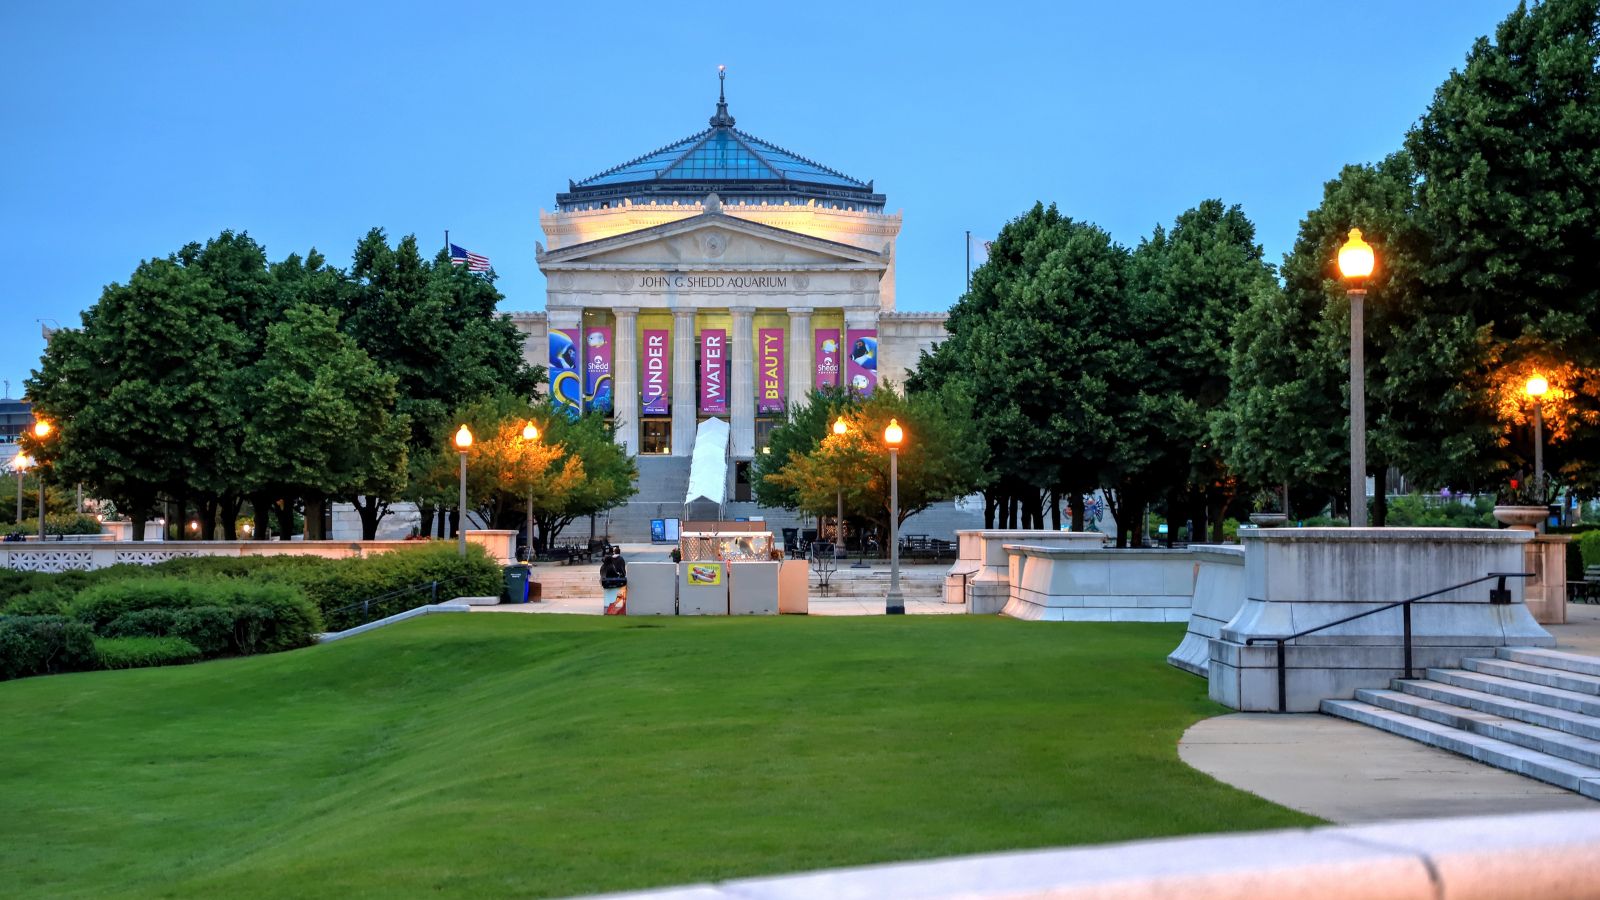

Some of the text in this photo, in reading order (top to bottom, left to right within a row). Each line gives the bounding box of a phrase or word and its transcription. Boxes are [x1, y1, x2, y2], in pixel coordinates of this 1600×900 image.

[639, 277, 670, 288] JOHN
[687, 276, 724, 288] SHEDD
[728, 276, 787, 288] AQUARIUM
[648, 336, 662, 396] UNDER
[706, 336, 720, 398] WATER
[764, 334, 778, 399] BEAUTY
